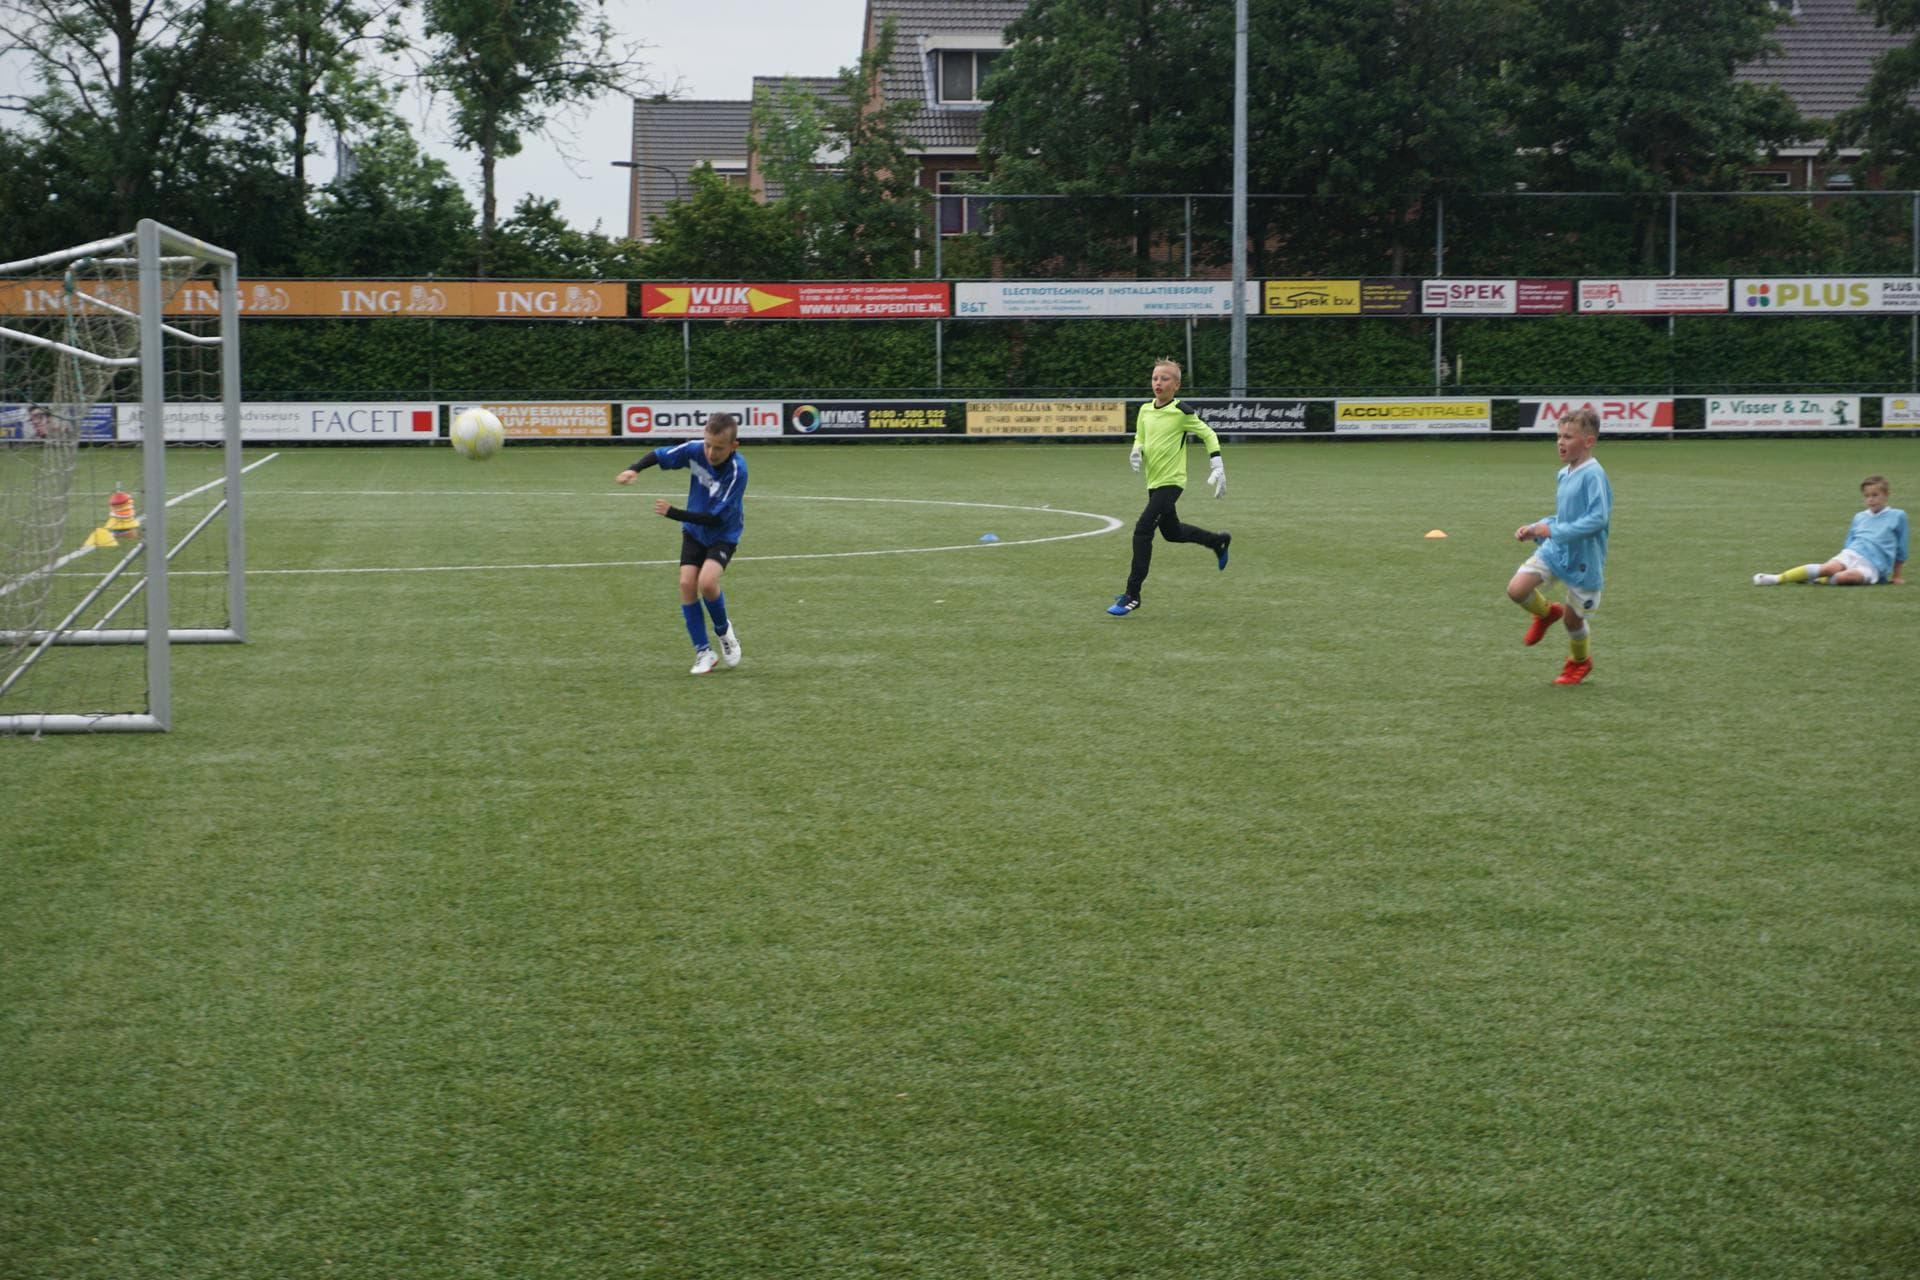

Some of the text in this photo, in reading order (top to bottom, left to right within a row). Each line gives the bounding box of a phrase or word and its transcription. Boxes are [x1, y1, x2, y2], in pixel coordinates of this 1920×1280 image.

[1002, 286, 1216, 297] ELECTROTECHNISCH INSTALLATIEBEDRIJF
[1450, 284, 1506, 299] SPEK
[1882, 283, 1913, 292] PLUS
[340, 291, 402, 312] ING
[497, 292, 558, 312] ING
[690, 287, 751, 304] VUIK
[1776, 283, 1870, 307] PLUS
[799, 303, 946, 315] WWW.VUIK-EXPEDITIE.NL
[960, 302, 988, 313] B&T
[1341, 405, 1474, 419] ACCUCENTRALE
[1710, 399, 1824, 414] P. Visser & Zn.
[240, 410, 301, 422] dviseurs
[311, 409, 404, 432] FACET
[869, 418, 947, 429] MYMOVE.NL
